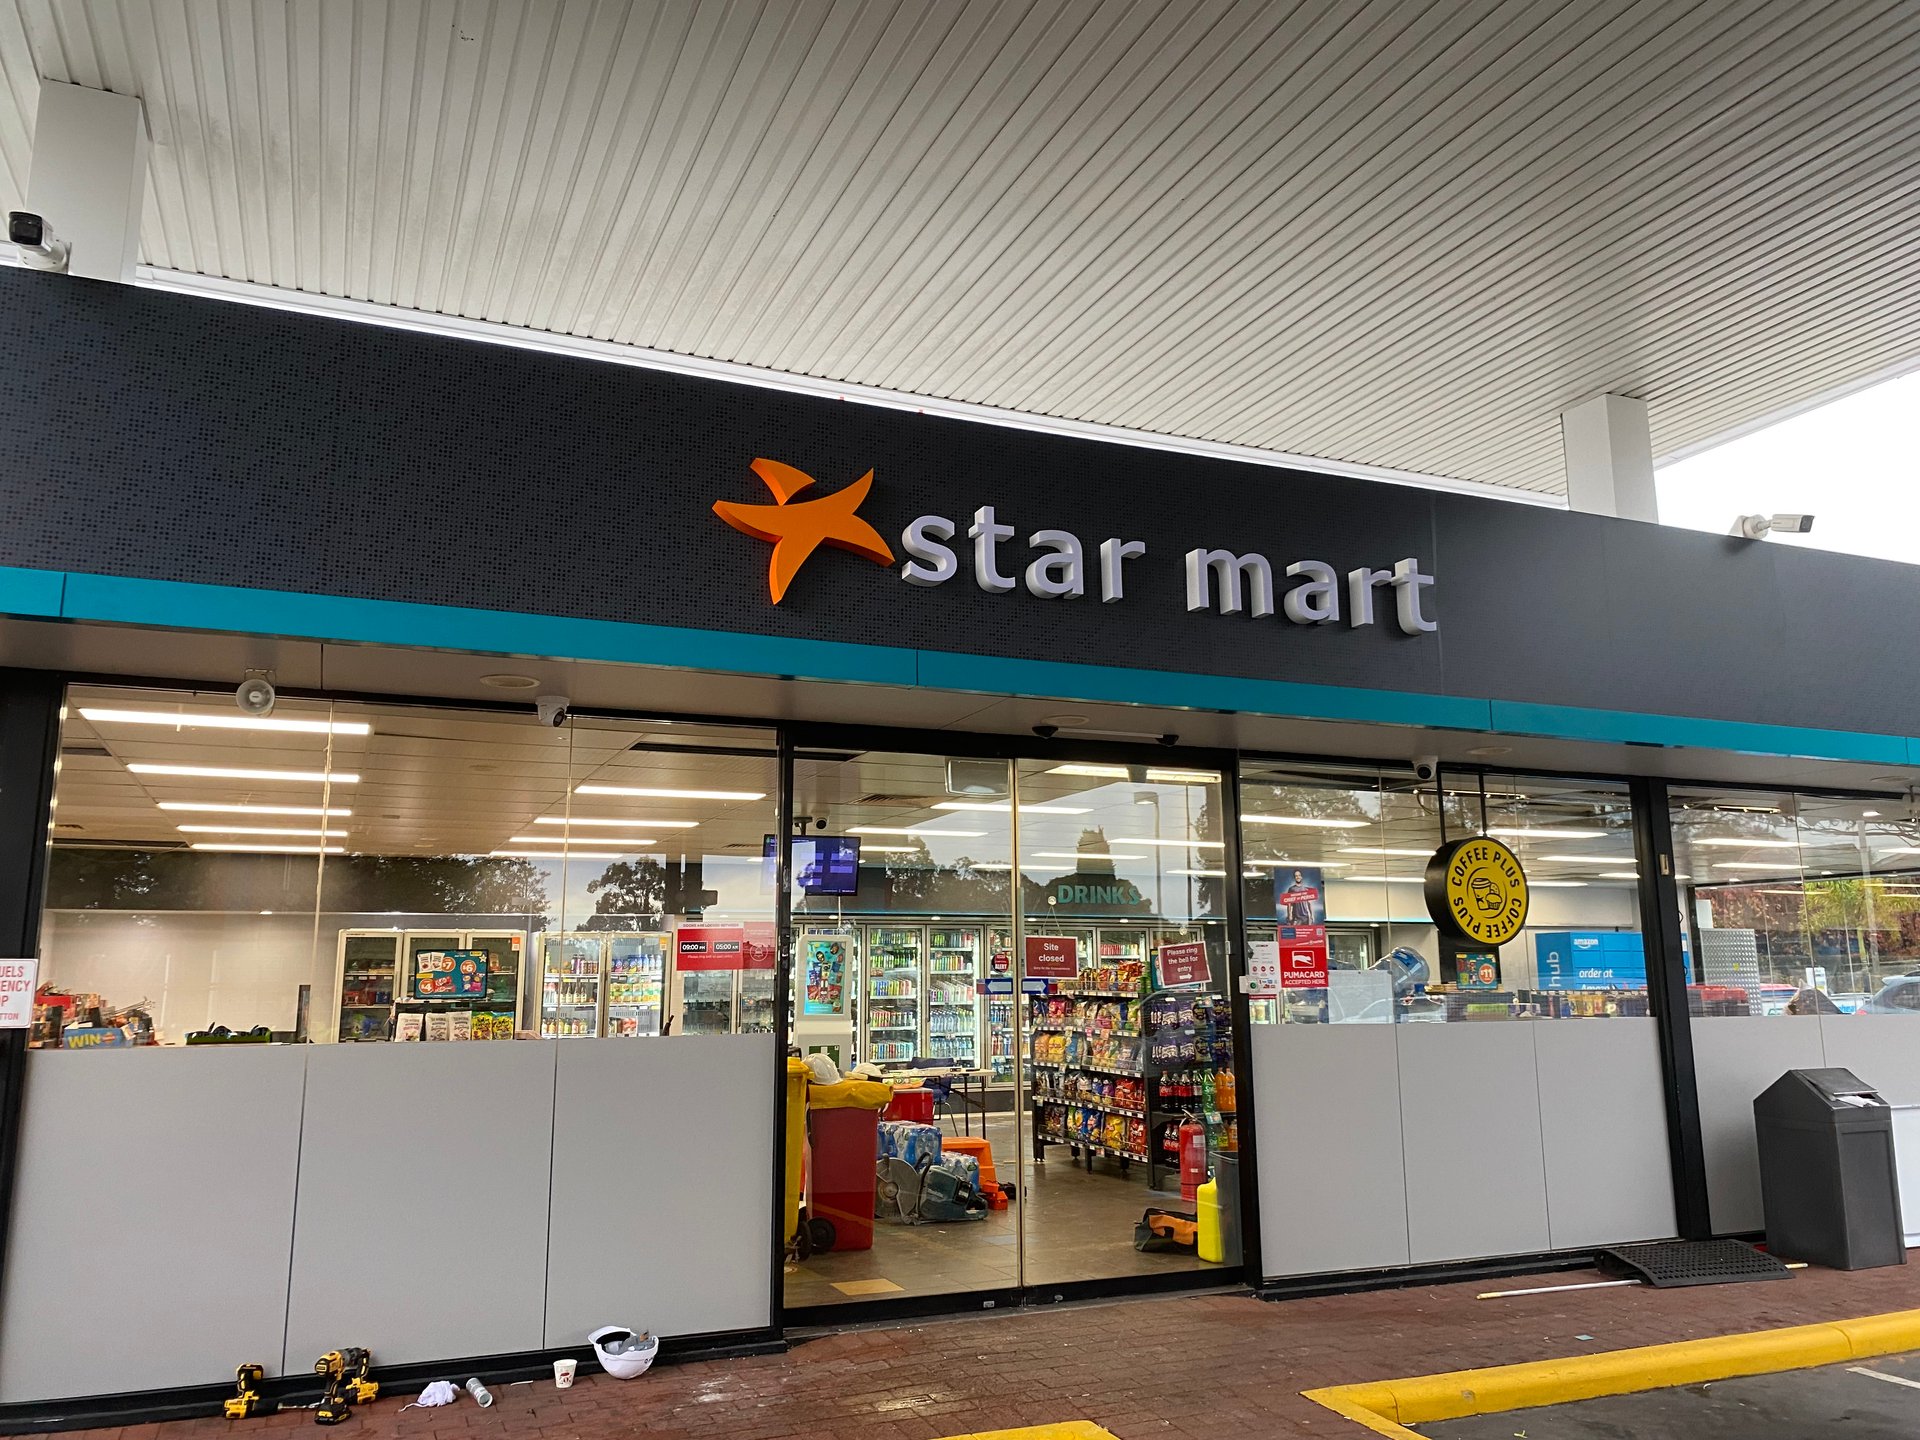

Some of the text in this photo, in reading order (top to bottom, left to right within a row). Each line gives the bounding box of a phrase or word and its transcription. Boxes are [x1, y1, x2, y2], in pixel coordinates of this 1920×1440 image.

[902, 505, 1437, 636] star mart
[1452, 847, 1520, 888] COFFEE PLUS
[1057, 884, 1141, 905] DRINKS
[1453, 897, 1522, 938] COFFEE PLUS
[1043, 942, 1059, 951] Site
[1167, 948, 1185, 956] Please
[1038, 954, 1065, 963] closed
[1178, 956, 1189, 964] bell
[1177, 965, 1192, 973] entry
[1546, 951, 1561, 987] hub
[1579, 968, 1613, 978] order at
[1283, 971, 1325, 979] PUMACARD
[67, 1033, 102, 1049] WIN
